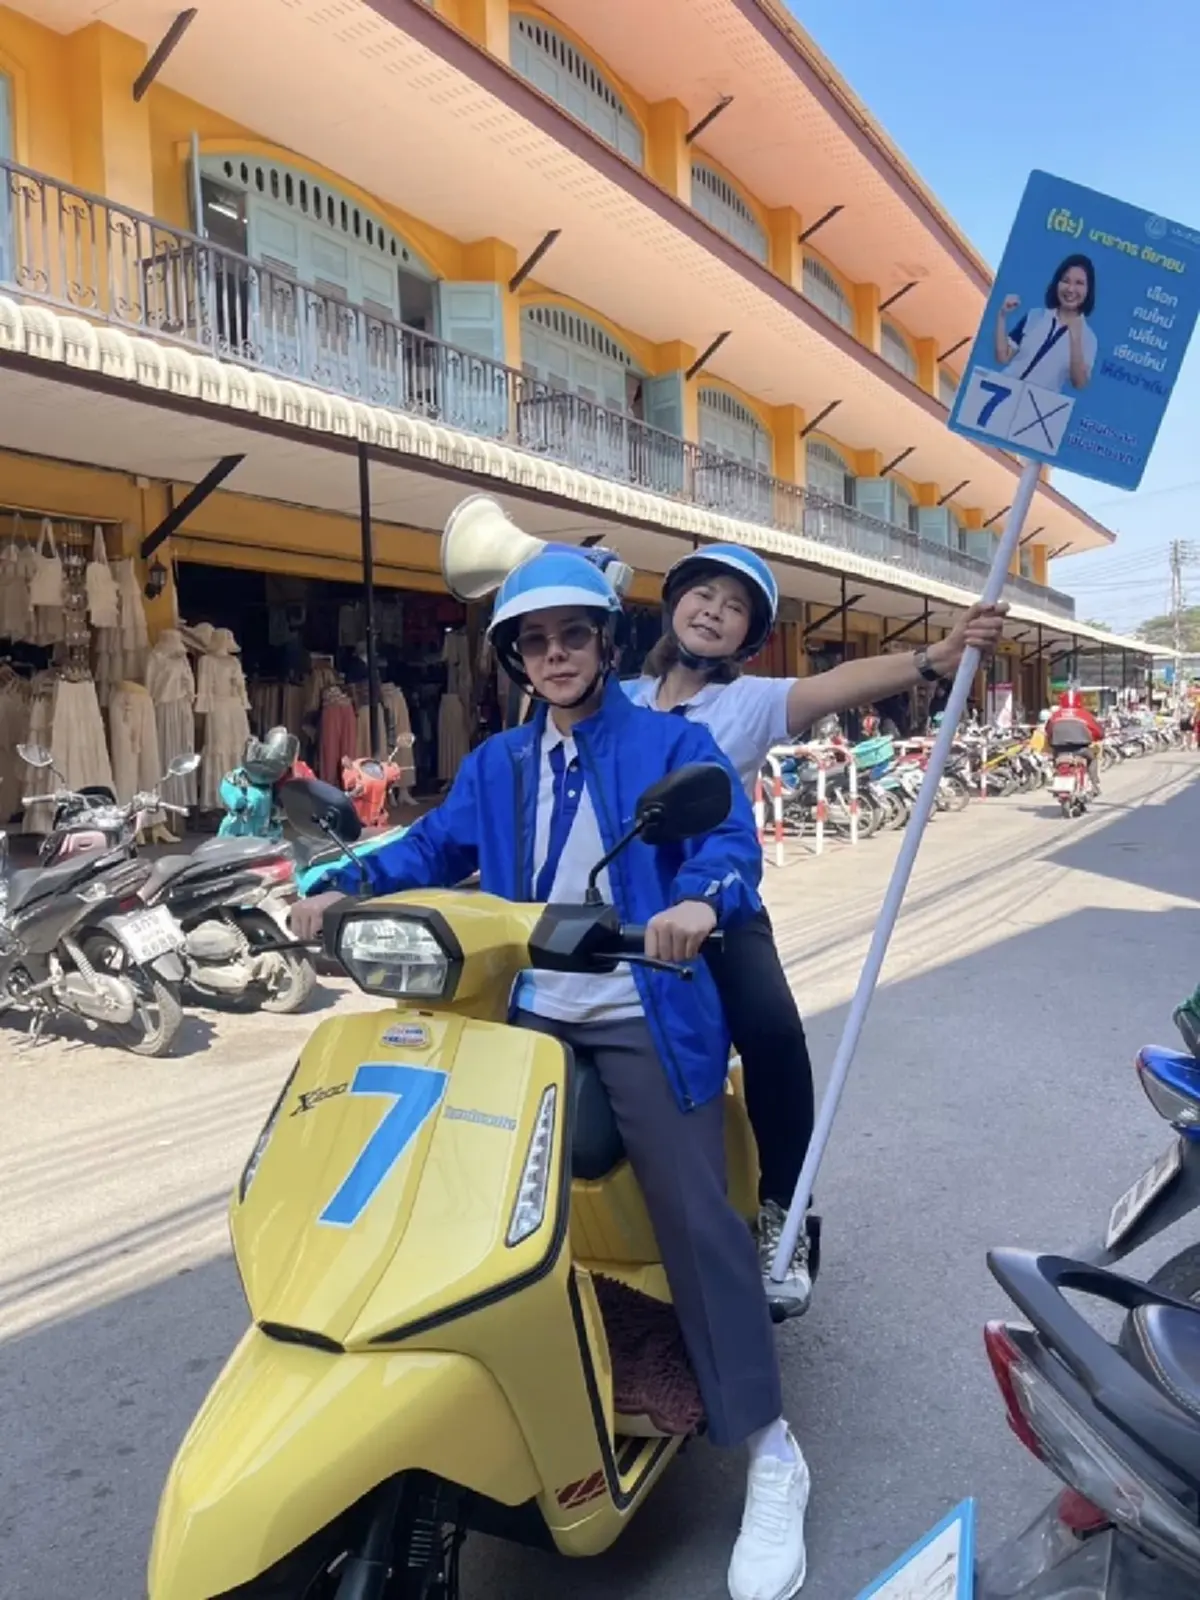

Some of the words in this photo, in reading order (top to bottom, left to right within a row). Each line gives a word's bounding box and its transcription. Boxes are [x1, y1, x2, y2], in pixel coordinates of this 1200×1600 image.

[1146, 286, 1178, 308] เลือก
[1133, 306, 1176, 329] คนใหม่
[1128, 325, 1168, 351] เปลี่ยน
[1113, 344, 1168, 372] เชียงใหม่
[977, 380, 1012, 428] 7
[316, 1061, 450, 1228] 7
